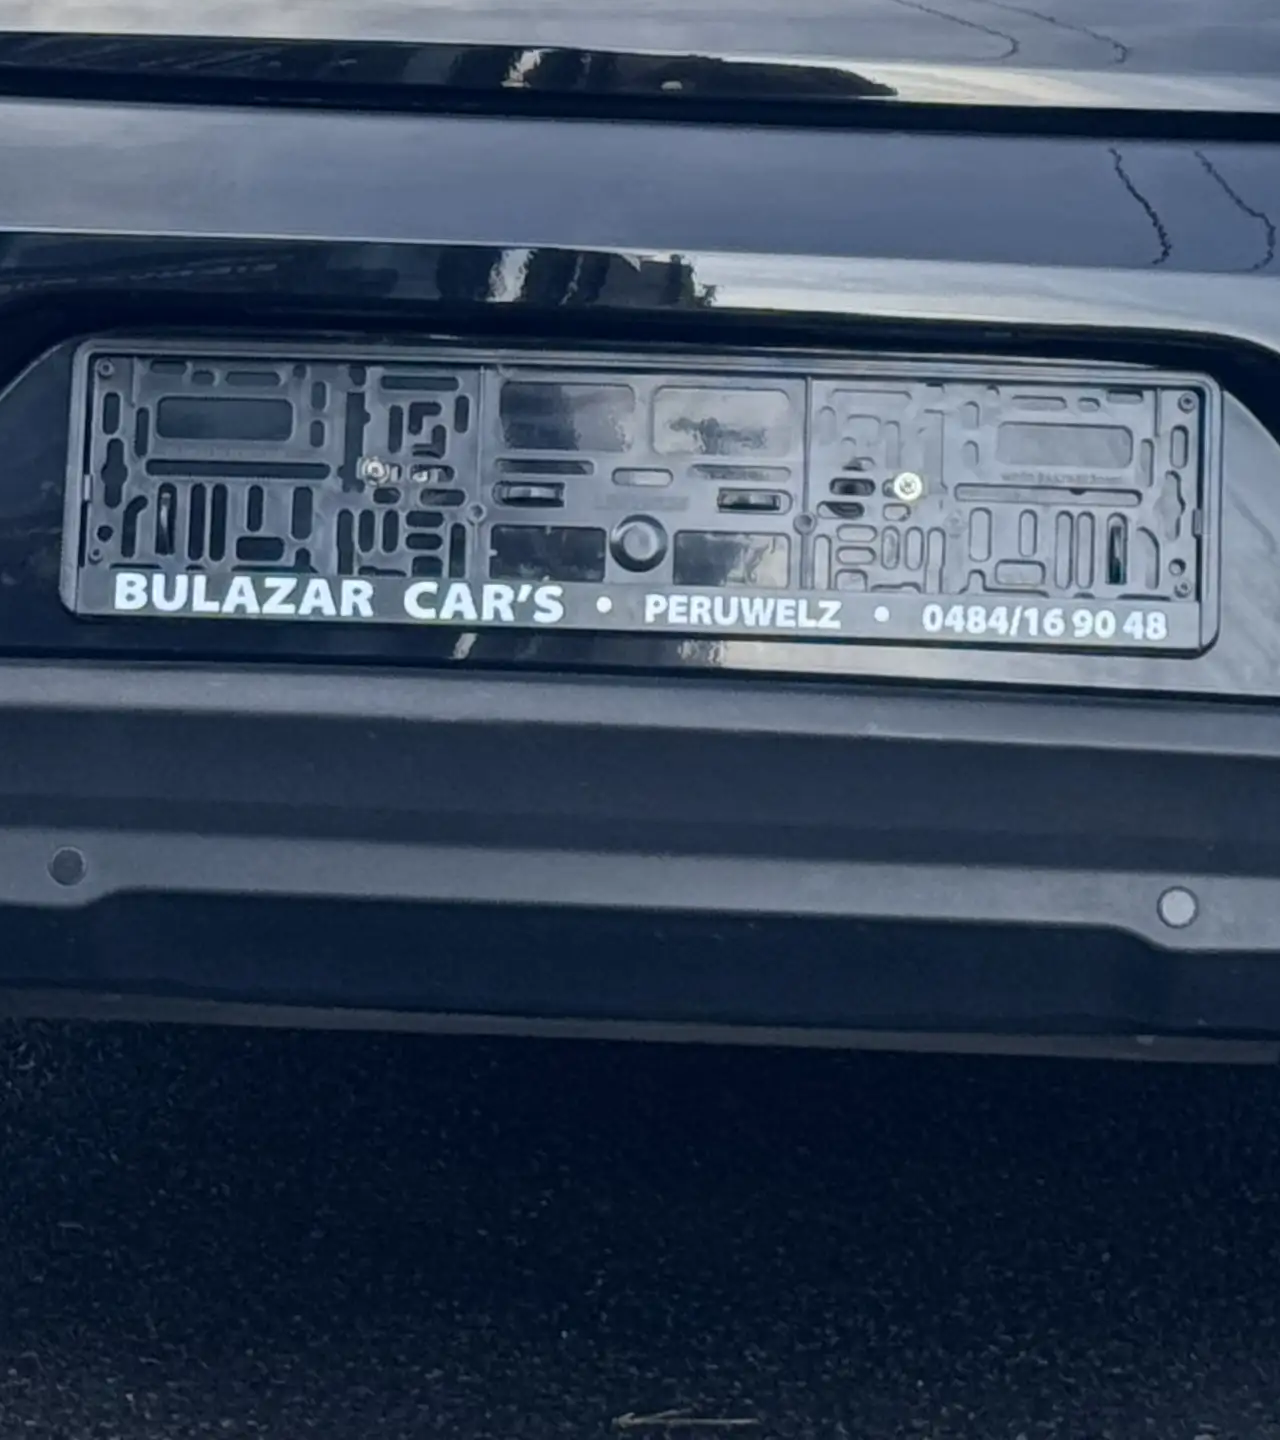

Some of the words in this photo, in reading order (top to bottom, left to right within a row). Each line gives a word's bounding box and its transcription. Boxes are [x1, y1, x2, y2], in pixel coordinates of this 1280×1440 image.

[113, 572, 375, 617] BULAZAR
[403, 581, 565, 624] CAR'S
[643, 593, 842, 630] PERUWELZ
[921, 603, 1065, 638] 0484/16
[1073, 608, 1116, 639] 90
[1123, 610, 1168, 641] 48
